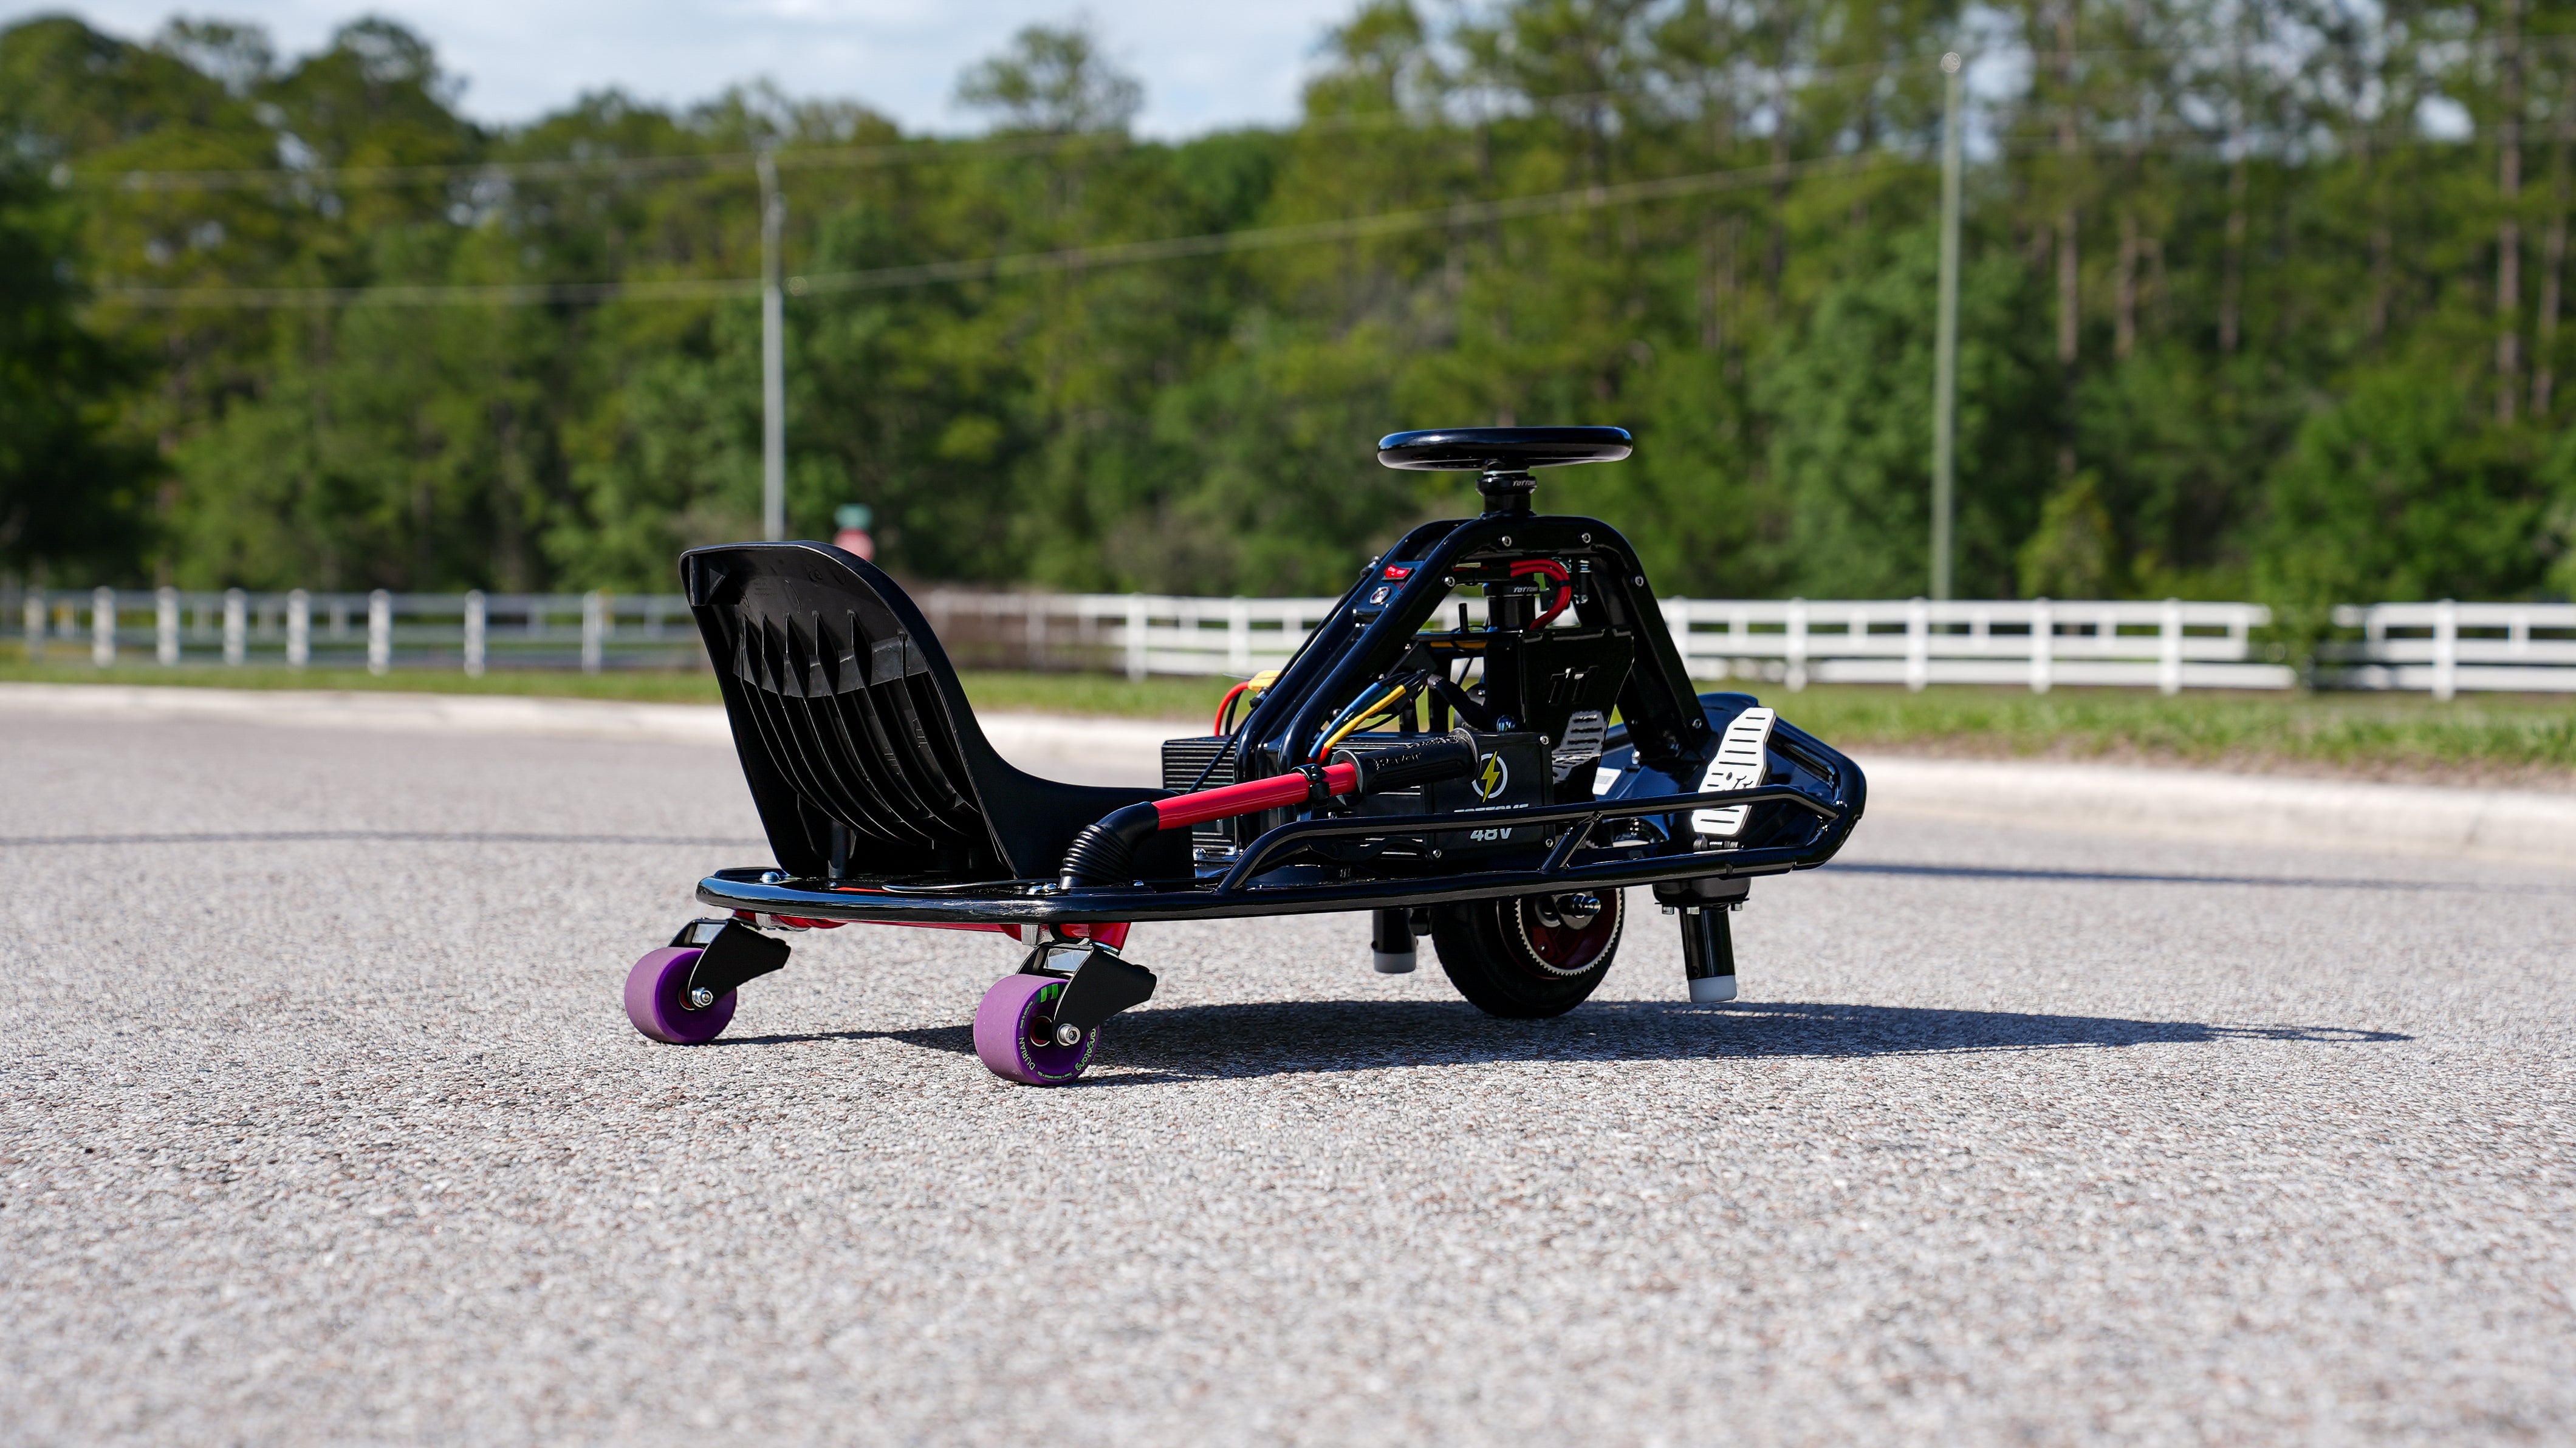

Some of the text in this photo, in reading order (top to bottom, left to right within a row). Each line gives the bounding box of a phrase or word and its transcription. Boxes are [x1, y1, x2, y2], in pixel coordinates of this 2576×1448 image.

[1470, 828, 1512, 842] 48V
[1018, 1036, 1036, 1071] DURIAN
[1075, 1028, 1097, 1071] rangatang
